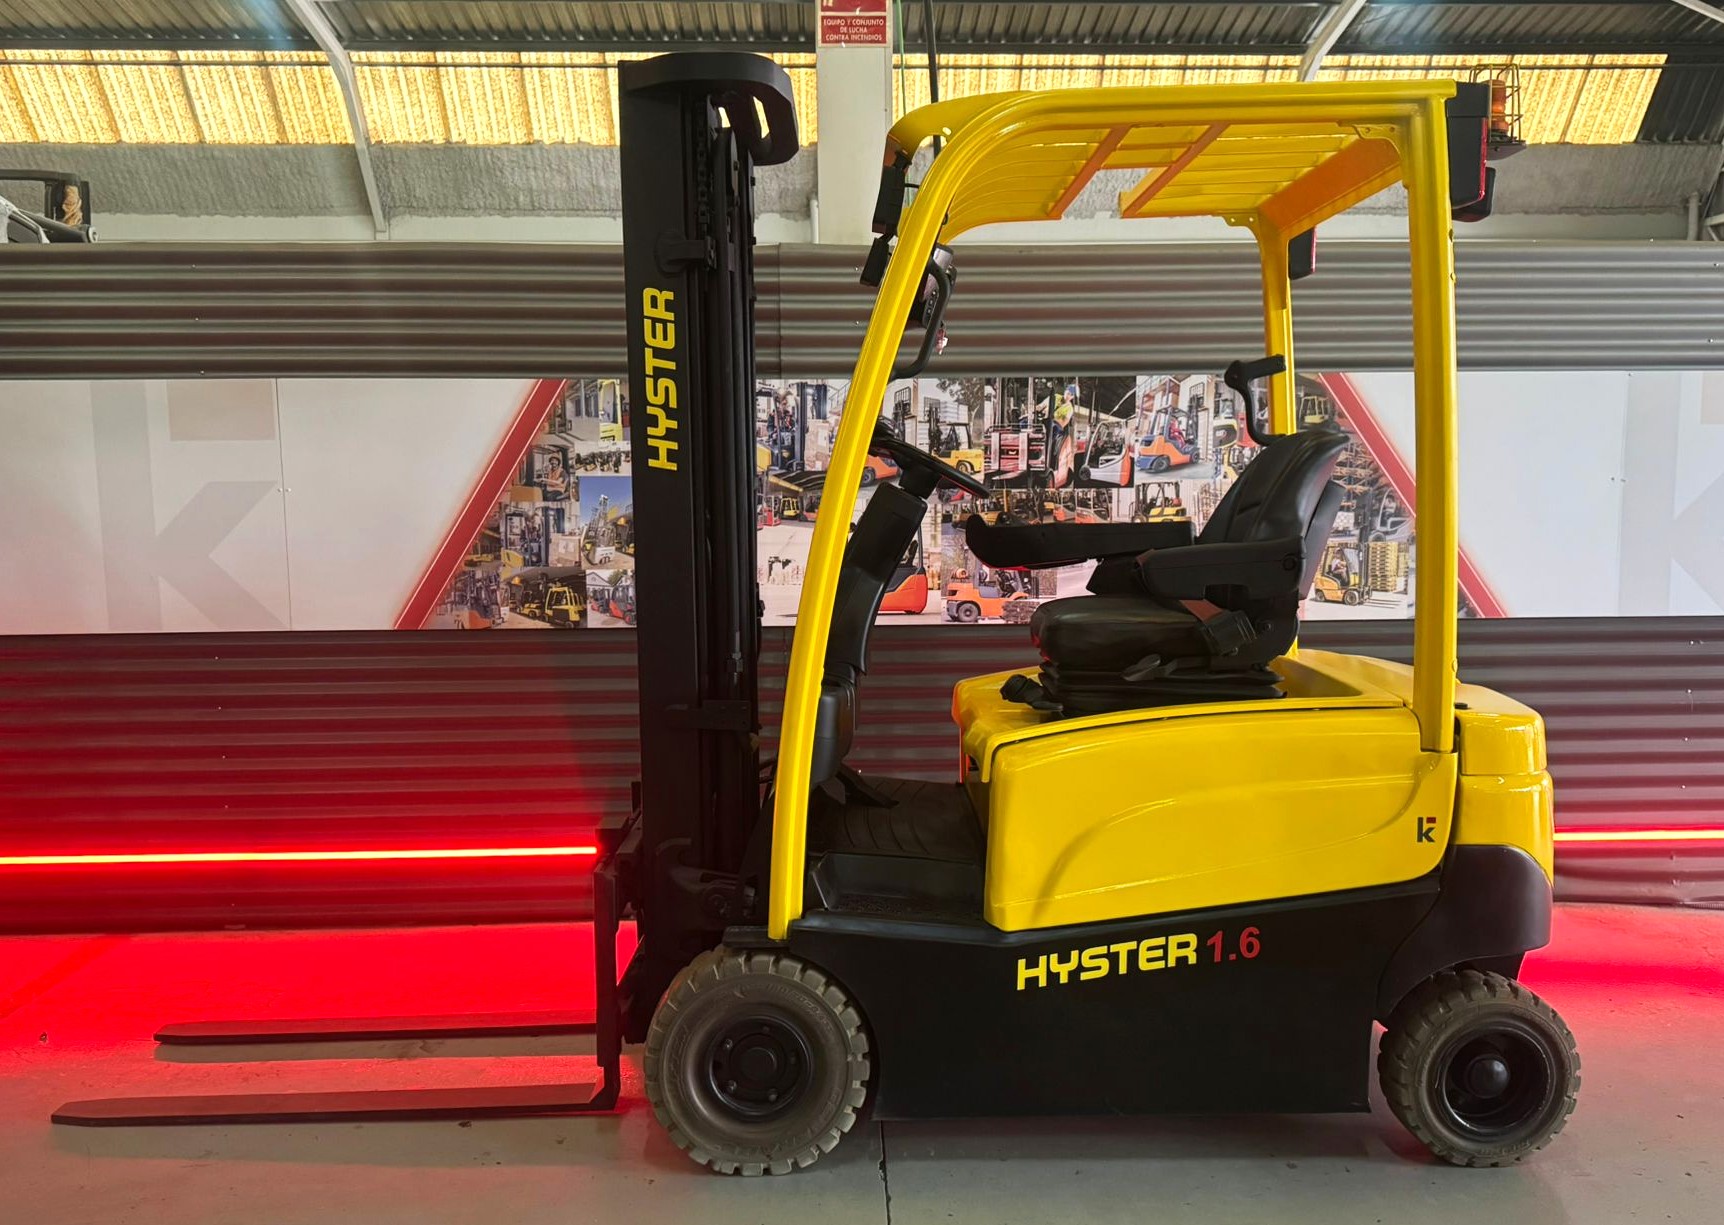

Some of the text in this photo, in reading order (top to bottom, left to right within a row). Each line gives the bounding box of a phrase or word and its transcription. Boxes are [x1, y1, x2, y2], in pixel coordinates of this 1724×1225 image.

[823, 18, 846, 26] EQUIPO
[852, 18, 884, 26] CONJUNTO
[643, 287, 678, 471] HYSTER
[1017, 926, 1261, 991] HYSTER 1.6
